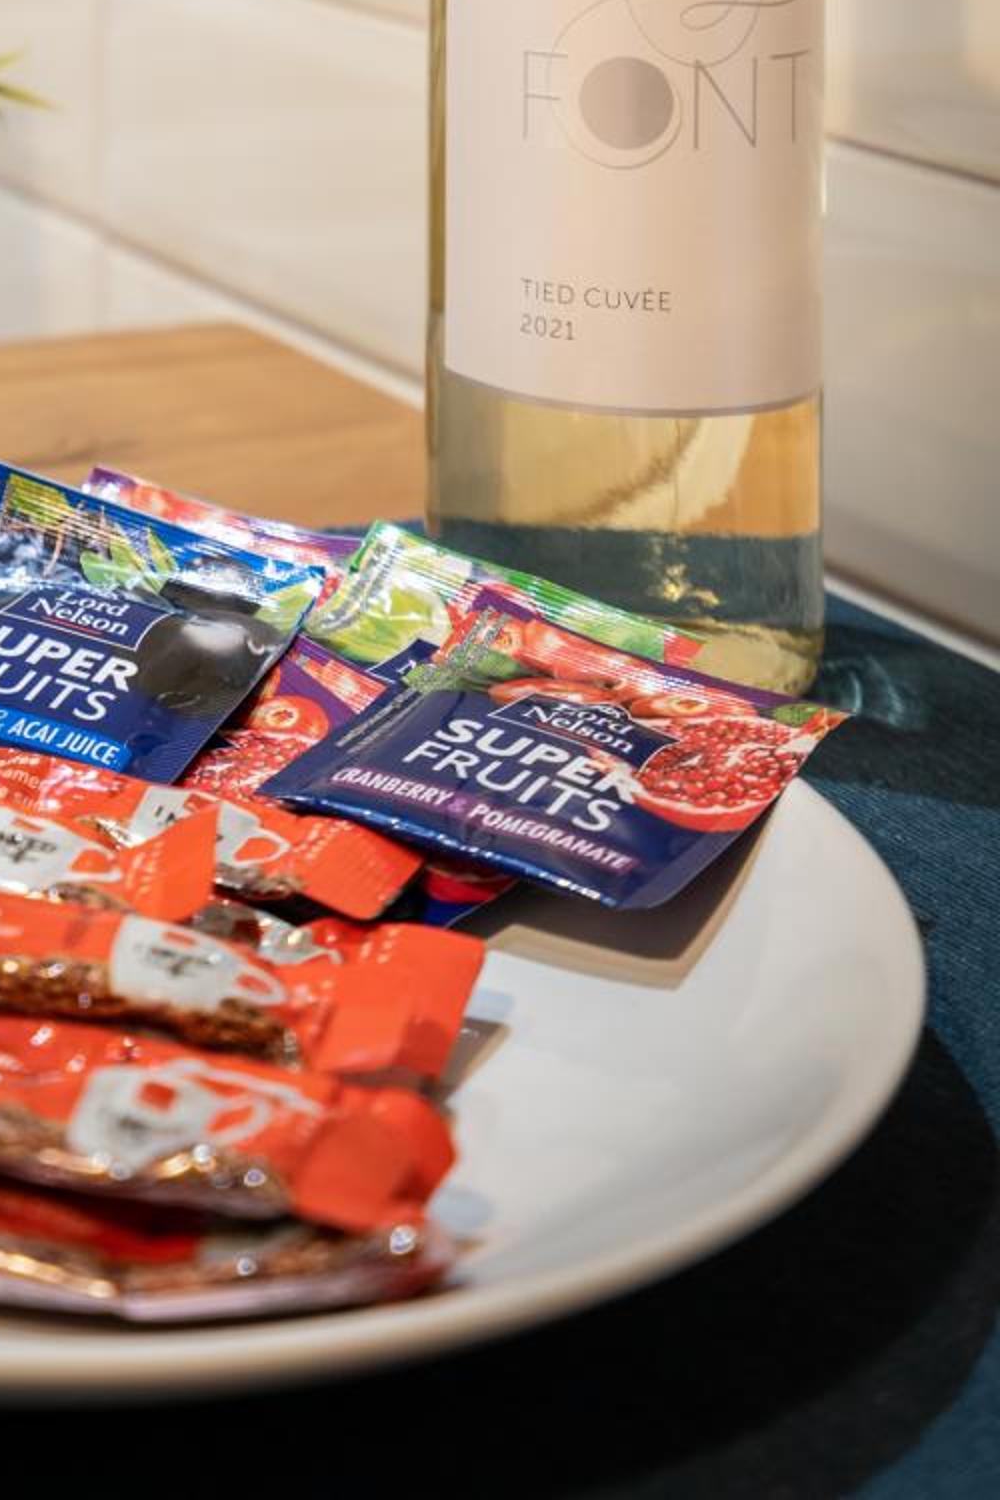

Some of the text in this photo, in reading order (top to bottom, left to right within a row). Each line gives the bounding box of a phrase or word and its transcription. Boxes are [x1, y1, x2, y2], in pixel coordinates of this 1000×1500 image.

[522, 50, 811, 170] FONT
[521, 278, 673, 312] TIED CUVÉE
[520, 314, 575, 342] 2021
[28, 598, 130, 636] Nelson
[56, 591, 131, 617] Lord
[8, 718, 58, 748] ACAI
[57, 731, 121, 765] JUICE
[523, 704, 635, 755] Nelson
[552, 702, 636, 736] Lord
[434, 719, 646, 805] SUPER
[402, 740, 622, 832] FRUITS
[331, 765, 454, 808] CRANBERRY
[468, 803, 635, 870] POMEGRANATE
